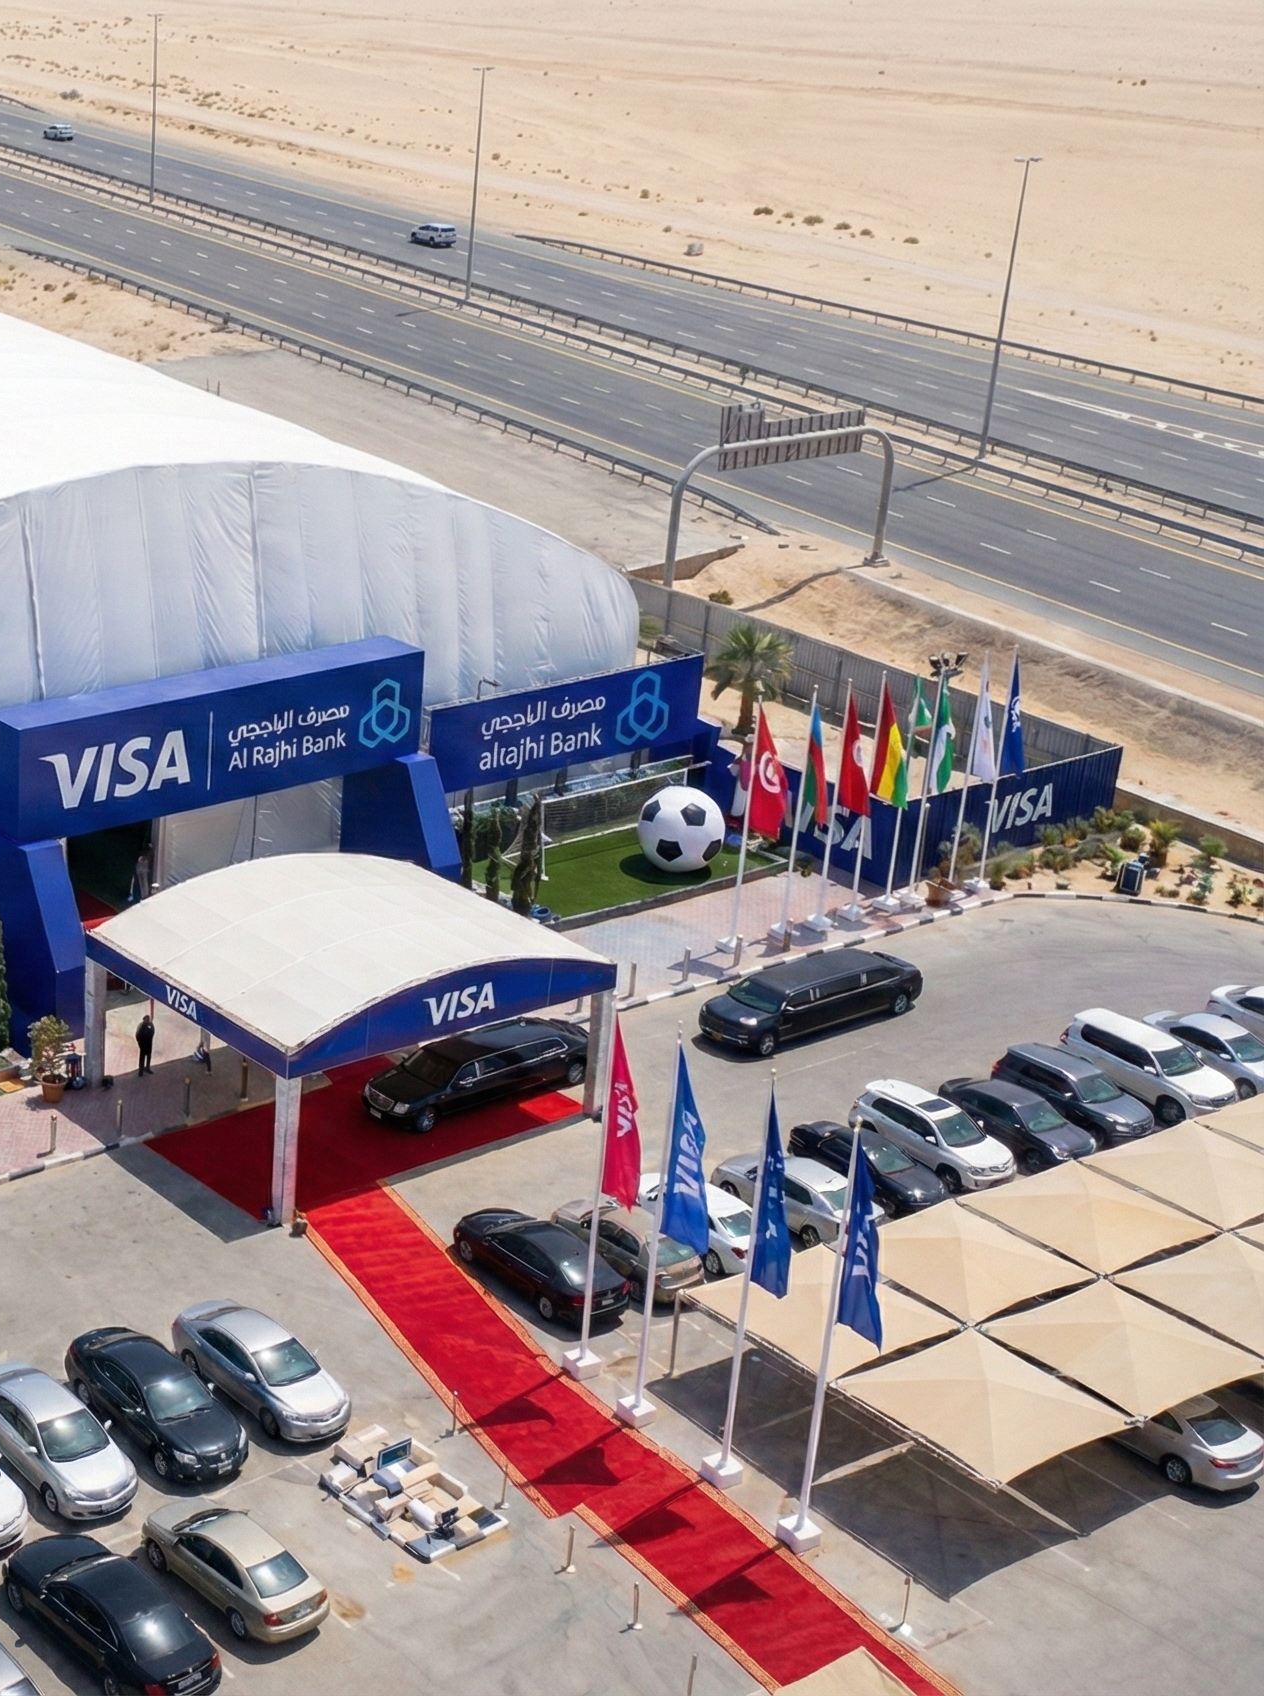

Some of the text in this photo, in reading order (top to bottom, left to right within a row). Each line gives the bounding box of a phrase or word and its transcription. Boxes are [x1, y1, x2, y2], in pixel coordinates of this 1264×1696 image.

[228, 728, 346, 771] Al Rajhi Bank
[550, 722, 602, 756] Bank
[38, 729, 191, 809] VISA
[985, 783, 1053, 833] VISA
[165, 984, 197, 1021] VISA
[423, 982, 495, 1026] VISA
